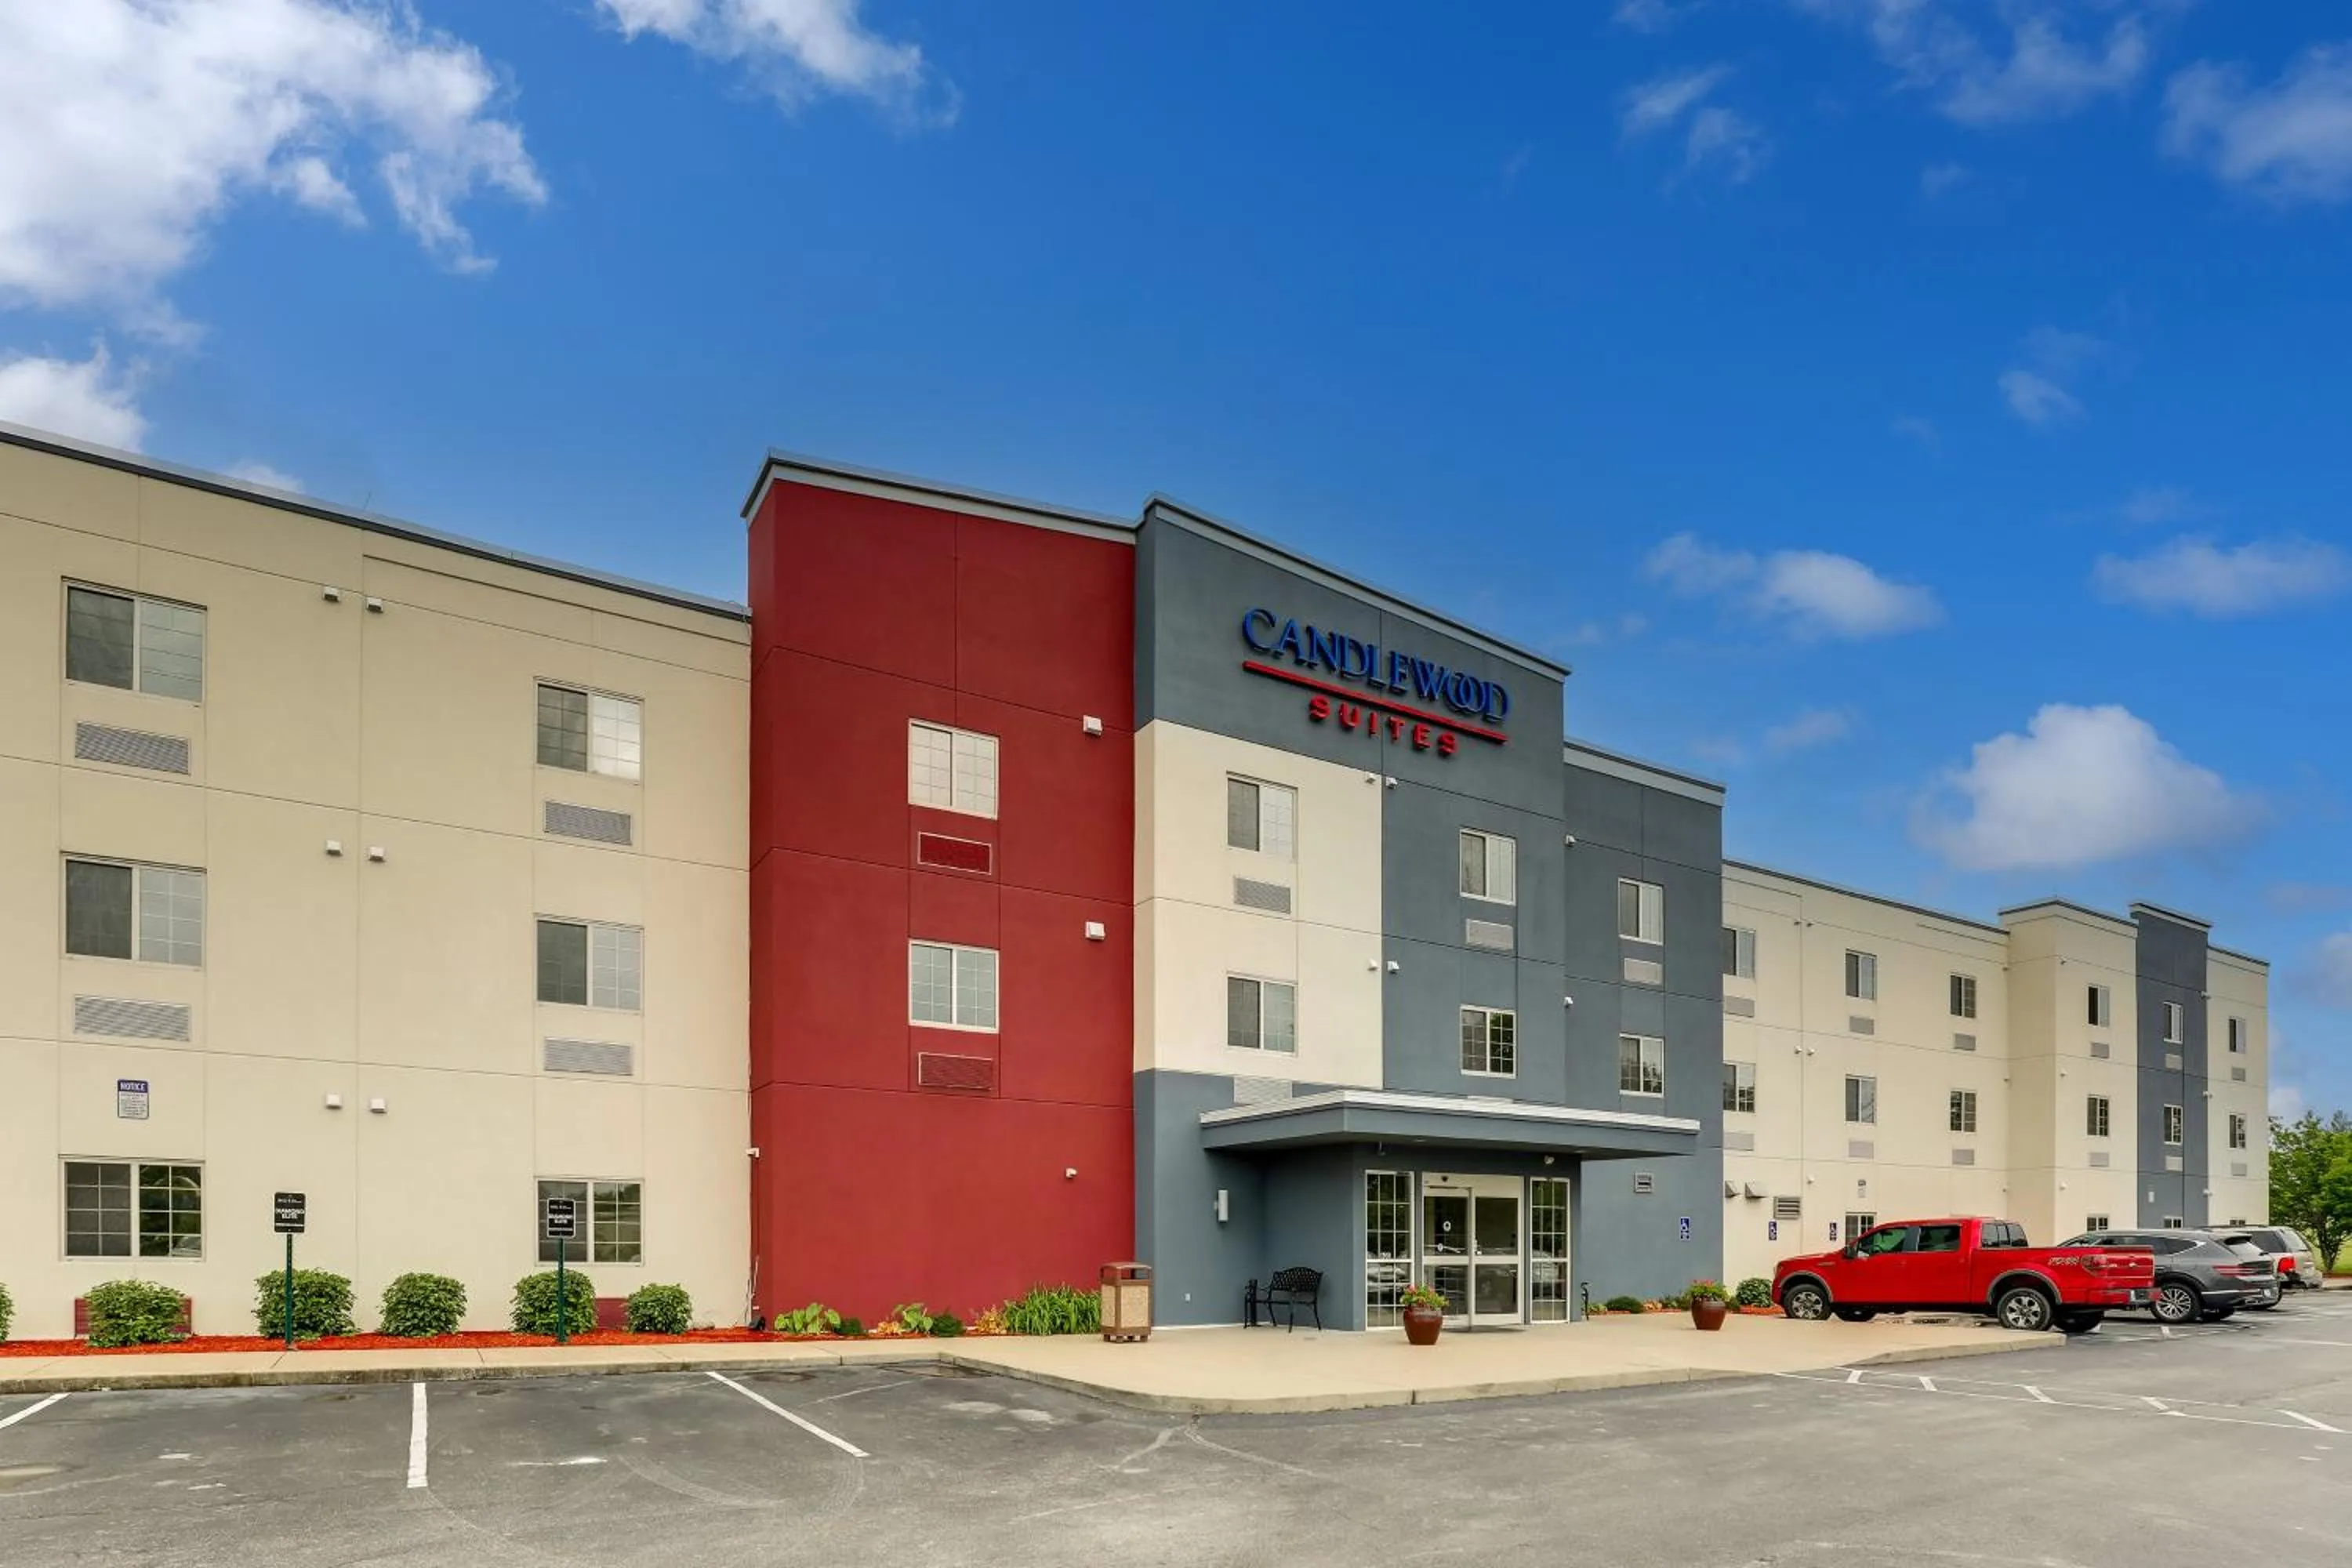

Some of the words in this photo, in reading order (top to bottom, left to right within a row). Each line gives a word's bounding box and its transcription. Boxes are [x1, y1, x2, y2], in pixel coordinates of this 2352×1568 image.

[1242, 608, 1510, 724] CANDLEWOOD
[1308, 694, 1458, 755] SUITES
[120, 1082, 146, 1091] NOTICE
